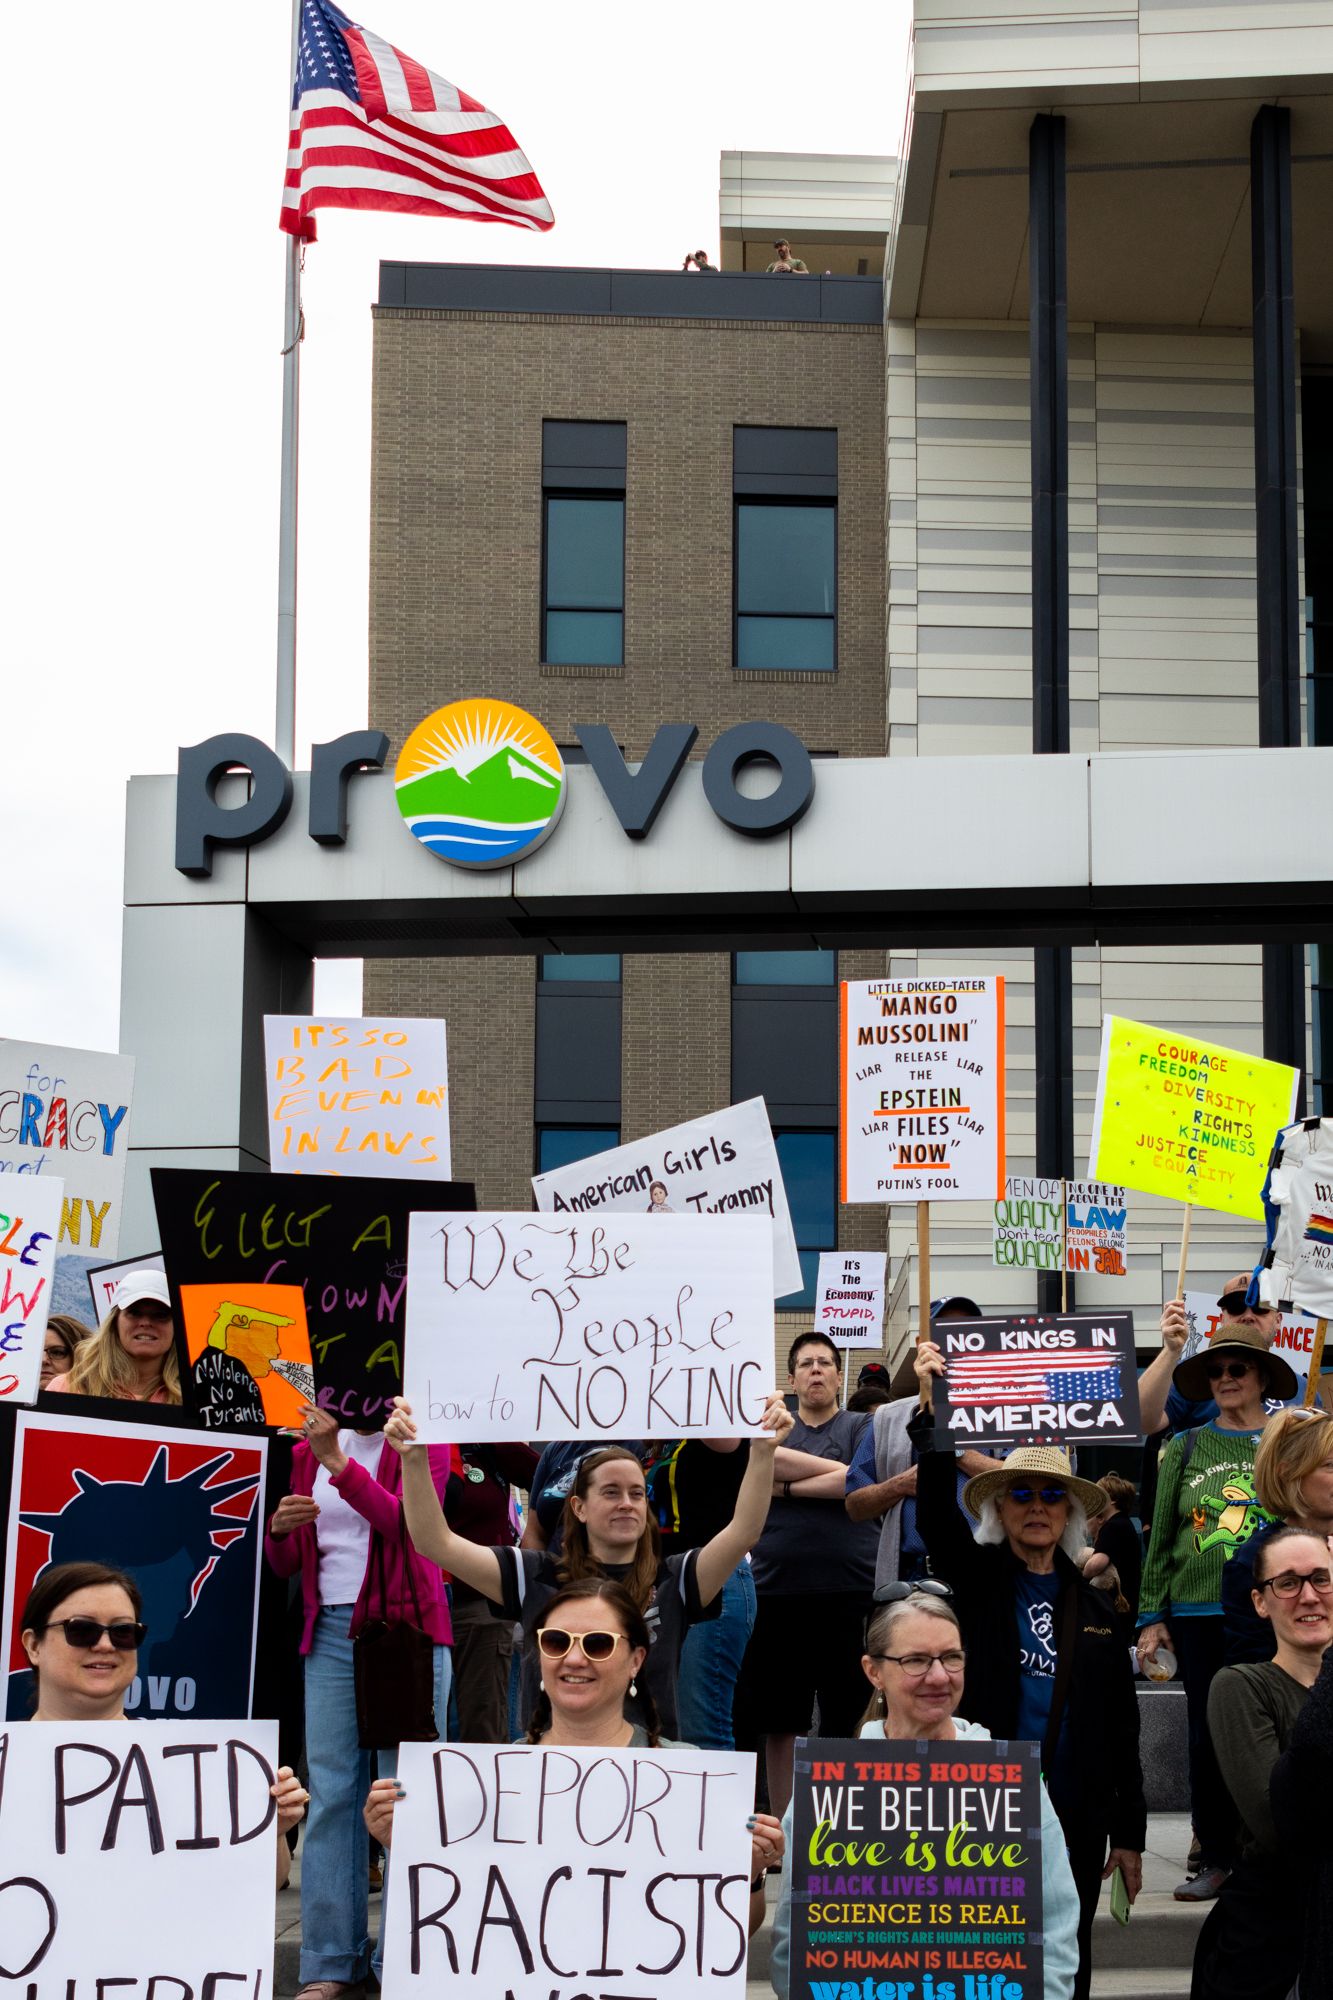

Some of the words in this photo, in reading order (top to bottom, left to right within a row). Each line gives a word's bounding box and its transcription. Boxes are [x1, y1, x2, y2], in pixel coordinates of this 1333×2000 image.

[868, 983, 903, 995] LITTLE
[907, 981, 985, 993] DICKED-TATER
[895, 1051, 948, 1062] RELEASE
[957, 1058, 984, 1076] LIAR
[1139, 1054, 1208, 1084] FREEDOM
[1158, 1042, 1229, 1073] COURAGE
[26, 1063, 67, 1093] for
[276, 1055, 413, 1089] BAD
[856, 1063, 882, 1080] LIAR
[910, 1070, 932, 1080] THE
[273, 1088, 403, 1120] EVEN
[880, 1087, 961, 1109] EPSTEIN
[1163, 1079, 1256, 1117] DIVERSITY
[861, 1121, 889, 1136] LIAR
[897, 1116, 949, 1136] FILES
[957, 1115, 985, 1135] LIAR
[1194, 1109, 1253, 1139] RIGHTS
[1136, 1134, 1208, 1163] JUSTICE
[1179, 1125, 1256, 1157] KINDNESS
[553, 1165, 655, 1213] American
[663, 1136, 737, 1175] Girls
[1153, 1154, 1236, 1185] EQUALITY
[877, 1176, 922, 1190] PUTIN'S
[928, 1178, 959, 1189] FOOL
[1069, 1183, 1085, 1195] NO
[1088, 1184, 1108, 1196] ONE
[1114, 1186, 1126, 1197] IS
[1068, 1194, 1099, 1205] ABOVE
[1104, 1196, 1124, 1207] THE
[194, 1180, 333, 1260] ELECT
[352, 1215, 392, 1252] A
[1067, 1204, 1127, 1231] LAW
[998, 1228, 1030, 1241] Don't
[1034, 1227, 1061, 1242] fear
[1067, 1228, 1108, 1239] PEDOPHILES
[1111, 1231, 1126, 1240] AND
[1068, 1237, 1096, 1247] FELONS
[1099, 1239, 1125, 1249] BELONG
[430, 1219, 545, 1293] We
[844, 1260, 861, 1270] It's
[1068, 1247, 1089, 1271] IN
[1092, 1246, 1126, 1276] JAIL
[1313, 1244, 1331, 1260] NO
[842, 1274, 861, 1285] The
[523, 1284, 742, 1369] People
[829, 1325, 868, 1337] Stupid!
[946, 1333, 985, 1353] NO
[1000, 1329, 1077, 1350] KINGS
[1091, 1327, 1117, 1347] IN
[365, 1340, 400, 1380] A
[211, 1383, 234, 1404] No
[428, 1379, 475, 1421] bow
[487, 1373, 515, 1421] to
[535, 1364, 628, 1432] NO
[647, 1360, 769, 1430] KING
[200, 1402, 265, 1428] Tyrants
[947, 1402, 1125, 1433] AMERICA
[1189, 1474, 1205, 1489] NO
[811, 1761, 846, 1780] IN
[854, 1762, 921, 1781] THIS
[929, 1763, 1022, 1782] HOUSE
[55, 1739, 277, 1856] PAID
[433, 1749, 739, 1858] DEPORT
[811, 1786, 864, 1831] WE
[881, 1787, 1022, 1832] BELIEVE
[808, 1820, 892, 1867] love
[899, 1831, 937, 1873] is
[945, 1821, 1029, 1867] love
[808, 1875, 876, 1896] BLACK
[881, 1875, 938, 1897] LIVES
[944, 1876, 1026, 1897] MATTER
[408, 1862, 749, 1978] RACISTS
[808, 1903, 921, 1923] SCIENCE
[929, 1904, 952, 1924] IS
[959, 1904, 1026, 1925] REAL
[808, 1931, 865, 1944] WOMEN'S
[867, 1931, 909, 1944] RIGHTS
[911, 1931, 936, 1944] ARE
[936, 1931, 980, 1944] HUMAN
[982, 1932, 1025, 1945] RIGHTS
[805, 1950, 838, 1969] NO
[844, 1950, 919, 1969] HUMAN
[925, 1951, 941, 1969] IS
[946, 1951, 1027, 1969] ILLEGAL
[808, 1976, 915, 2000] water
[922, 1973, 956, 2000] is
[963, 1973, 1024, 2000] life
